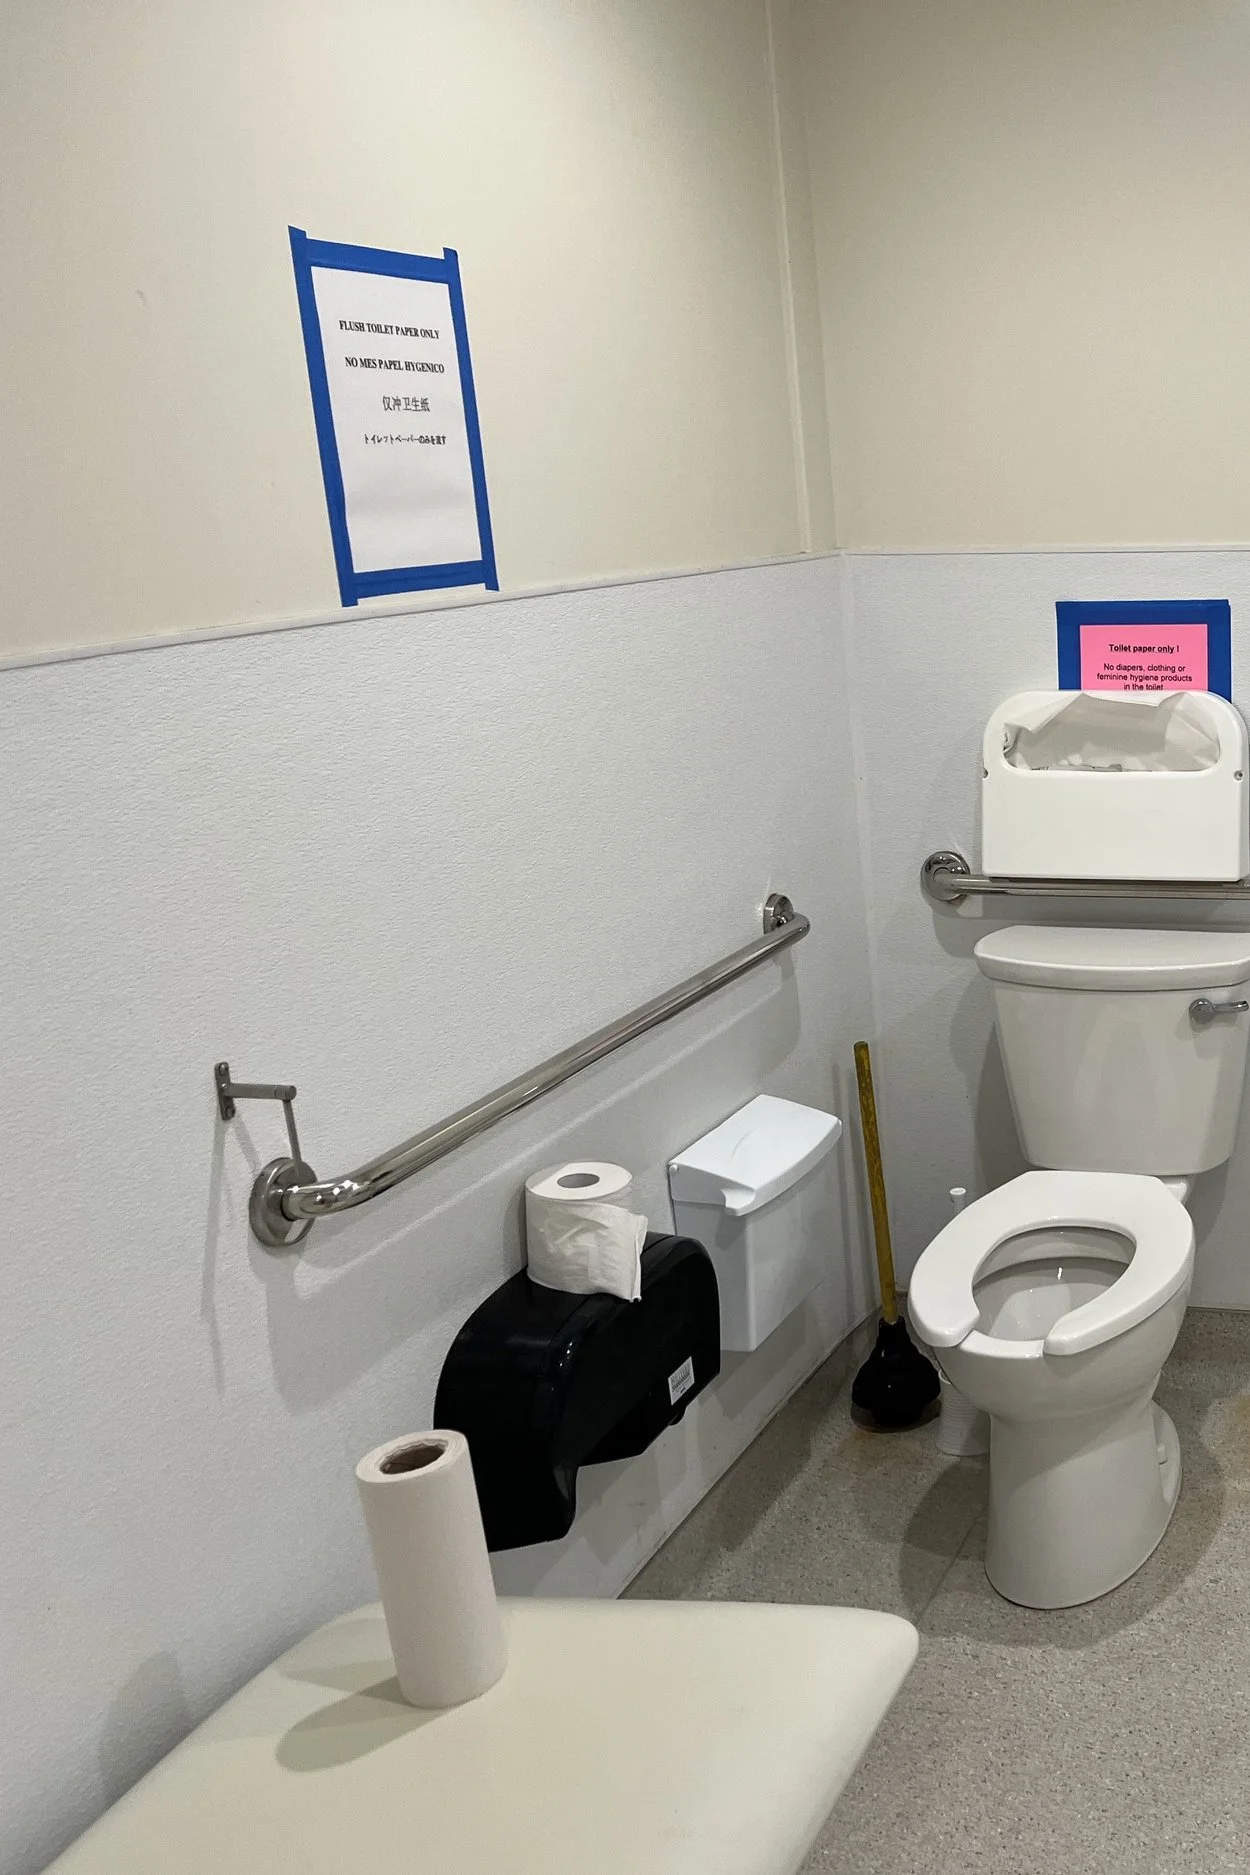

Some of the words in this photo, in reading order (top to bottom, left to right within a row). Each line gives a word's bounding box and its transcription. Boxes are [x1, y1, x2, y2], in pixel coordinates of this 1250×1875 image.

[339, 320, 366, 332] FLUSH
[366, 323, 394, 335] TOILET
[395, 326, 419, 337] PAPER
[420, 329, 440, 339] ONLY
[345, 357, 358, 368] NO
[359, 358, 377, 369] MES
[378, 359, 404, 370] PAPEL
[405, 361, 445, 374] HYGENICO
[382, 395, 431, 412] 仅冲卫生纸
[1108, 644, 1132, 653] Toilet
[1133, 645, 1156, 654] paper
[1157, 644, 1175, 654] only
[1103, 663, 1114, 671] No
[1116, 664, 1145, 672] diapers,
[1147, 664, 1176, 673] clothing
[1096, 673, 1128, 681] feminine
[1130, 674, 1158, 682] hygiene
[1160, 674, 1192, 682] products
